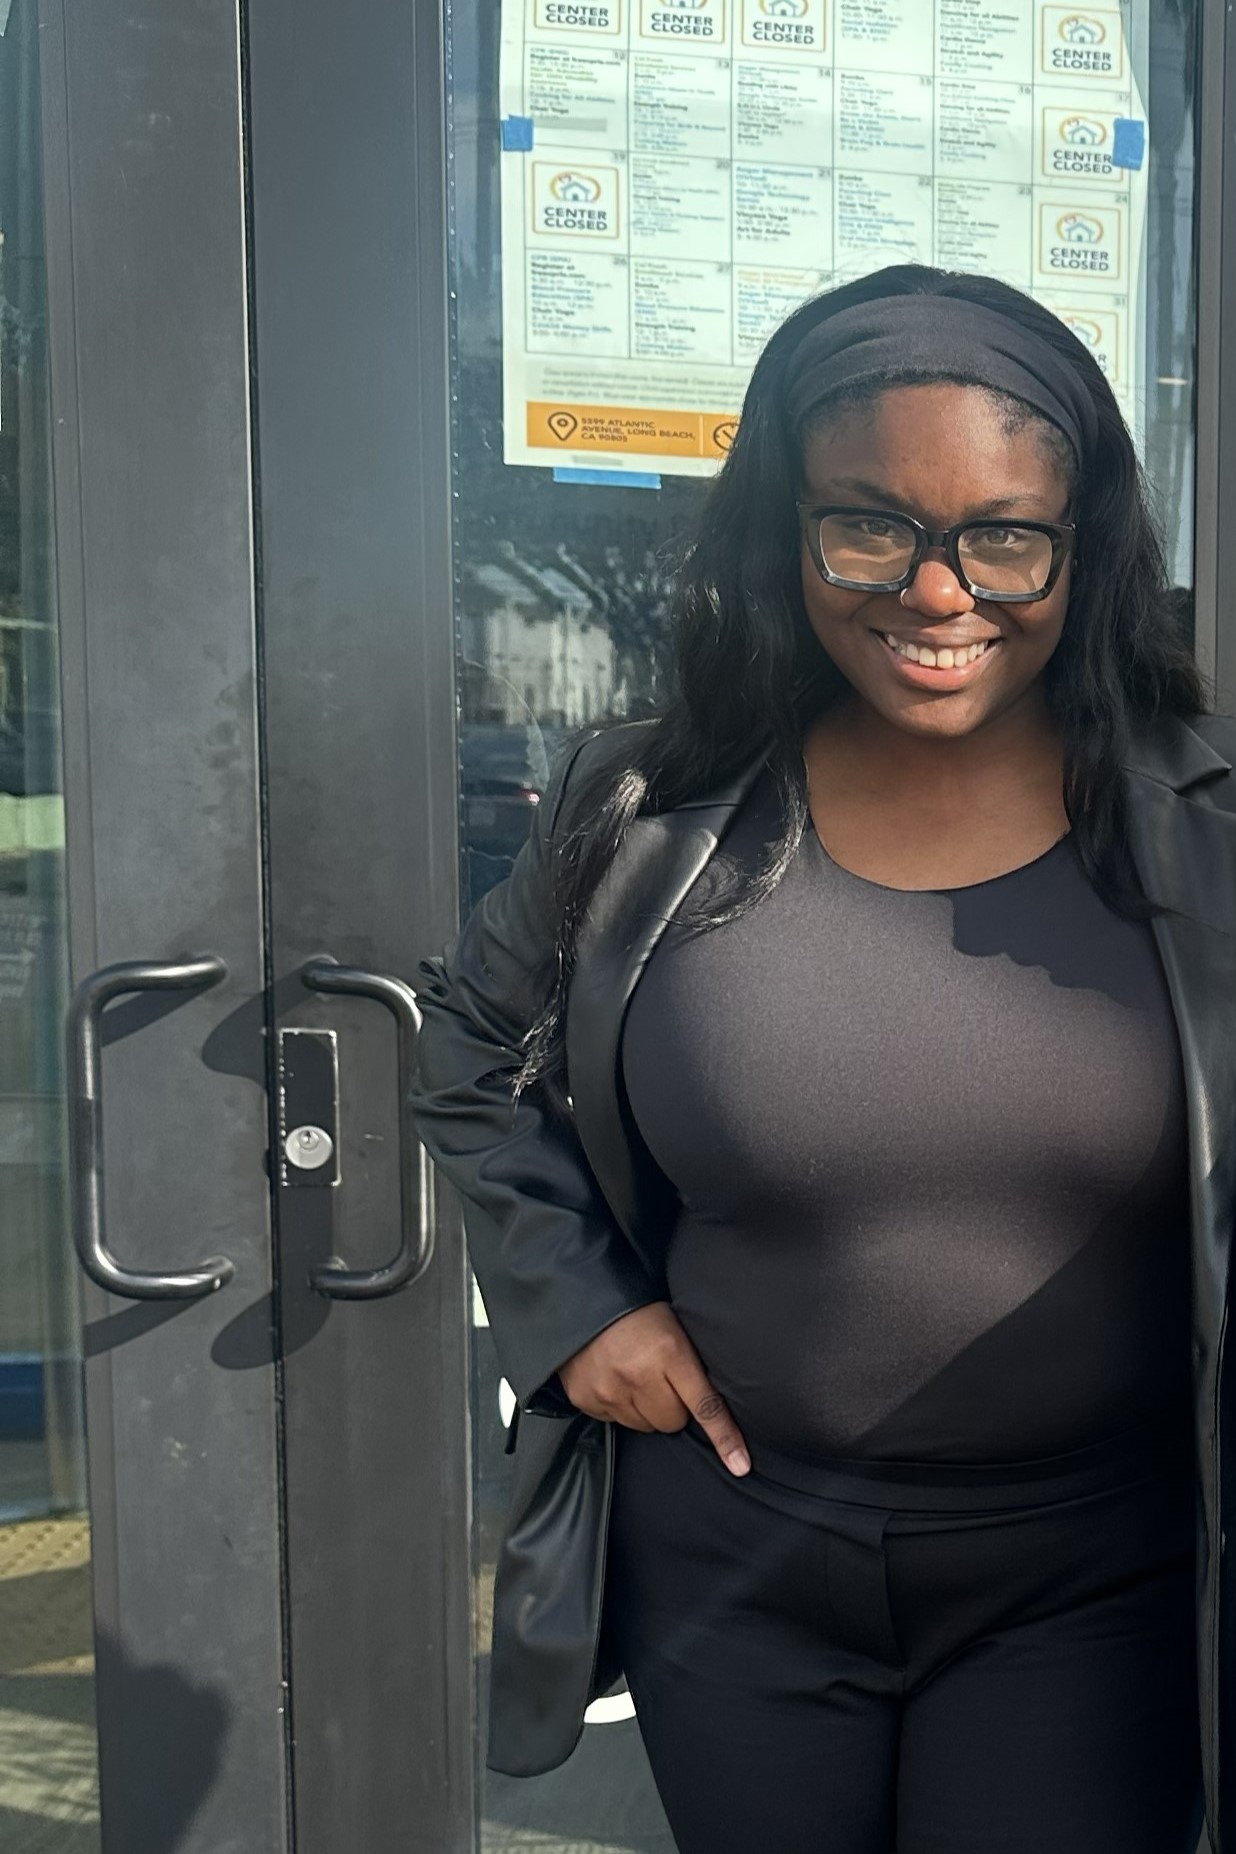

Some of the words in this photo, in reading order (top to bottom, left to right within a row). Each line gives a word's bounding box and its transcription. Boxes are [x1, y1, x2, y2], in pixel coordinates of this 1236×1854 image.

[546, 3, 609, 17] CENTER
[546, 13, 609, 27] CLOSED
[651, 12, 713, 26] CENTER
[651, 22, 713, 36] CLOSED
[752, 21, 814, 34] CENTER
[752, 31, 815, 44] CLOSED
[1052, 48, 1112, 62] CENTER
[1052, 59, 1112, 72] CLOSED
[820, 69, 830, 77] 14
[920, 77, 931, 86] 15
[1020, 85, 1031, 94] 16
[1053, 149, 1112, 163] CENTER
[818, 168, 831, 178] 21
[1053, 160, 1112, 174] CLOSED
[918, 177, 931, 186] 22
[1115, 195, 1128, 204] 24
[544, 207, 607, 220] CENTER
[544, 218, 608, 230] CLOSED
[1050, 247, 1109, 260] CENTER
[613, 256, 626, 265] 26
[1050, 258, 1109, 272] CLOSED
[718, 264, 730, 272] 27
[608, 419, 656, 428] ATLANTIC
[581, 432, 596, 440] CA
[582, 426, 624, 435] AVENUE,
[628, 428, 656, 436] LONG
[659, 430, 696, 441] BEACH,
